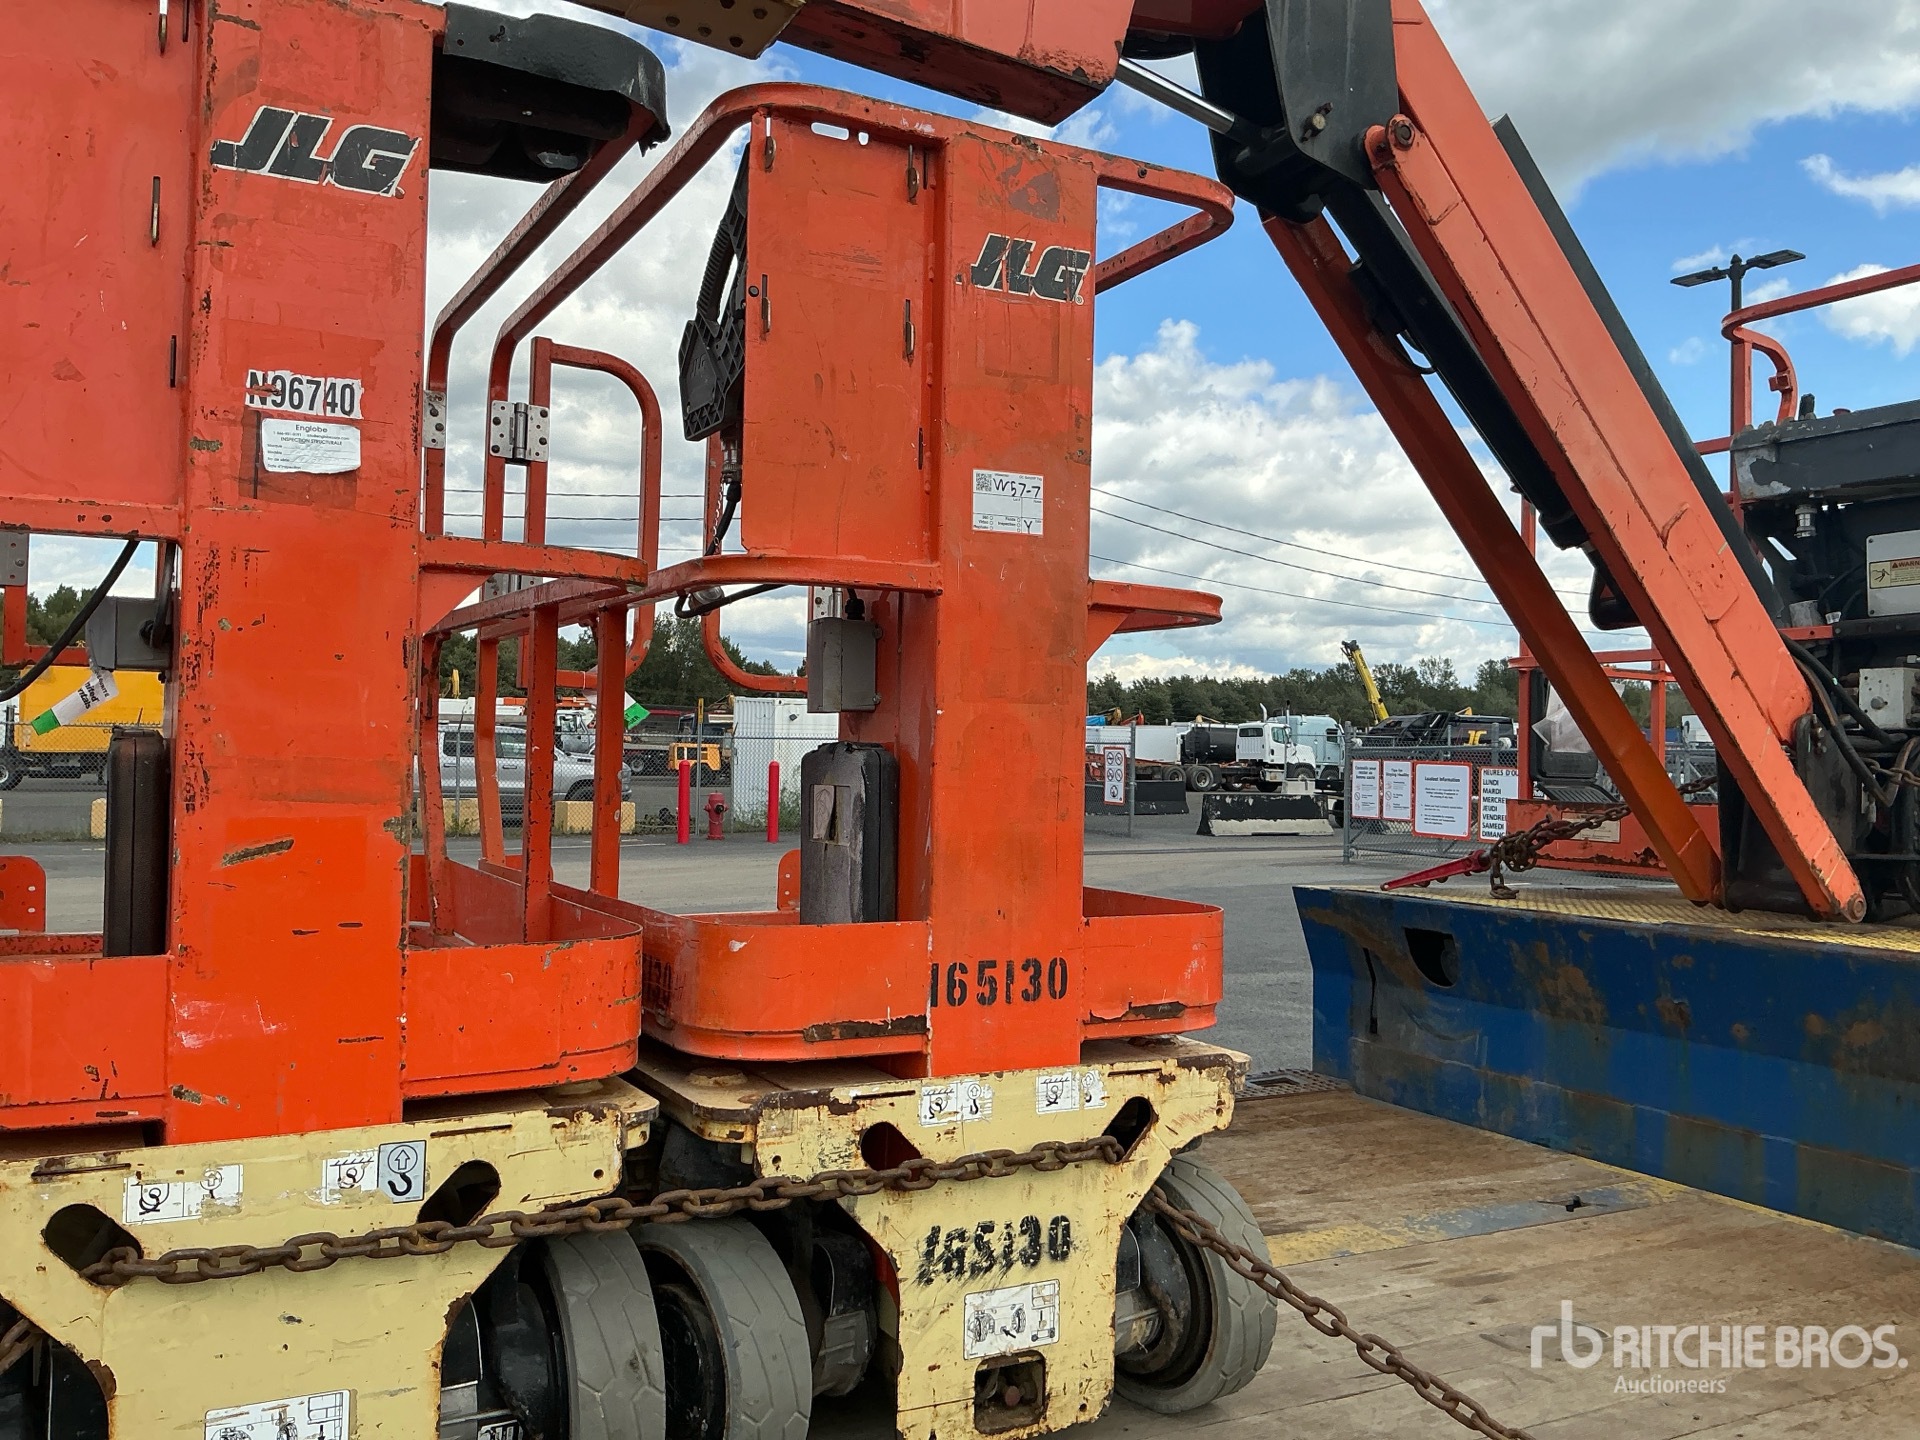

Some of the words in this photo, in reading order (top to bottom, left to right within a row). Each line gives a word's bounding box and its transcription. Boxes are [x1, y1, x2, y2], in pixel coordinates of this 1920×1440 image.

[209, 105, 422, 198] JLG
[956, 232, 1091, 303] JLG
[249, 371, 355, 417] N96740
[280, 436, 310, 444] INSPECTION
[310, 438, 342, 446] STRUCTURALE
[295, 424, 328, 433] Englobe
[1899, 560, 1920, 568] WARN
[84, 681, 100, 703] nited
[930, 956, 1068, 1008] 165130
